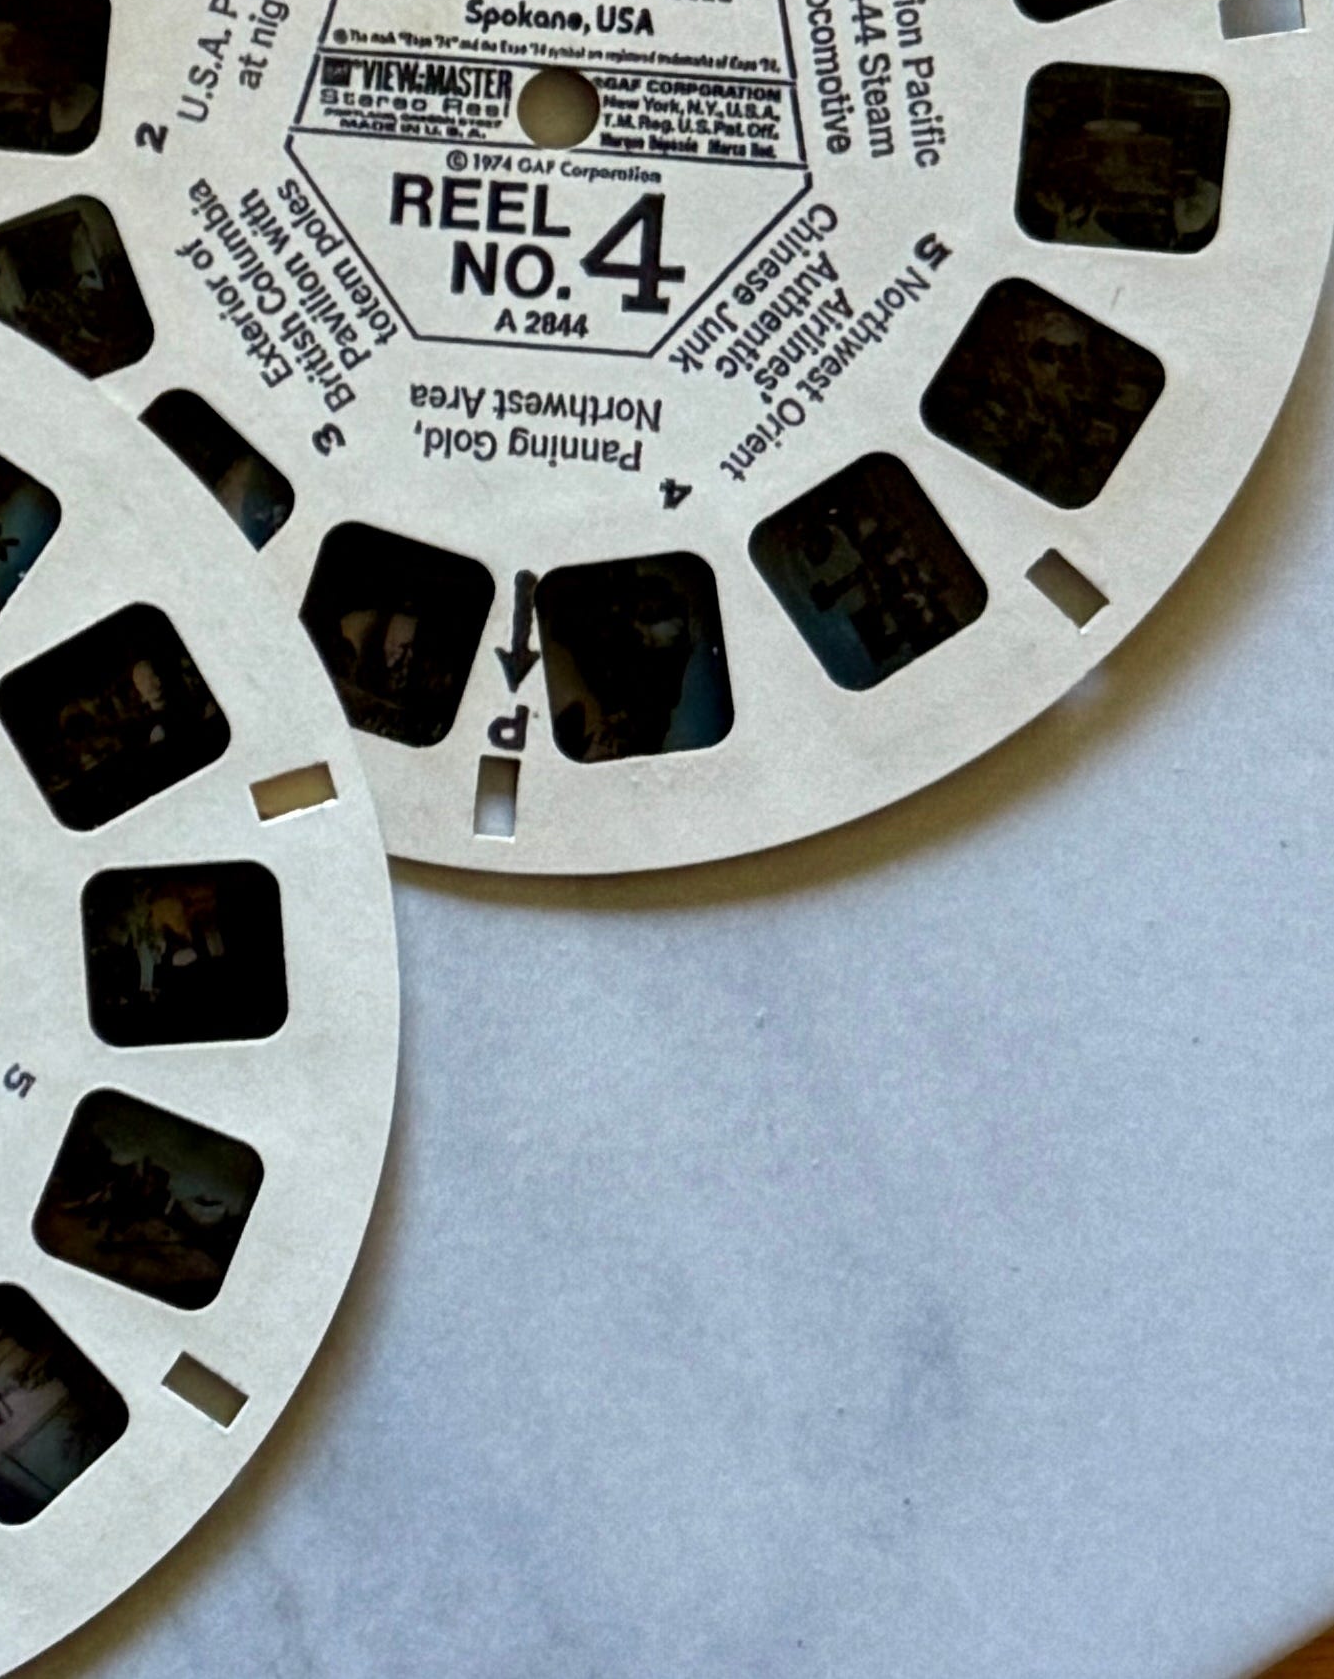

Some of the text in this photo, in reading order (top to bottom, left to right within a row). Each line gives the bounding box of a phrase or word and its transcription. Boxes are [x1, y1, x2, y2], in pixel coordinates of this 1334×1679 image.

[596, 4, 654, 35] USA
[857, 52, 894, 158] Steam
[901, 55, 946, 168] Pacific
[390, 172, 571, 237] REEL
[450, 192, 685, 314] NO. 4
[494, 308, 588, 338] A 2844
